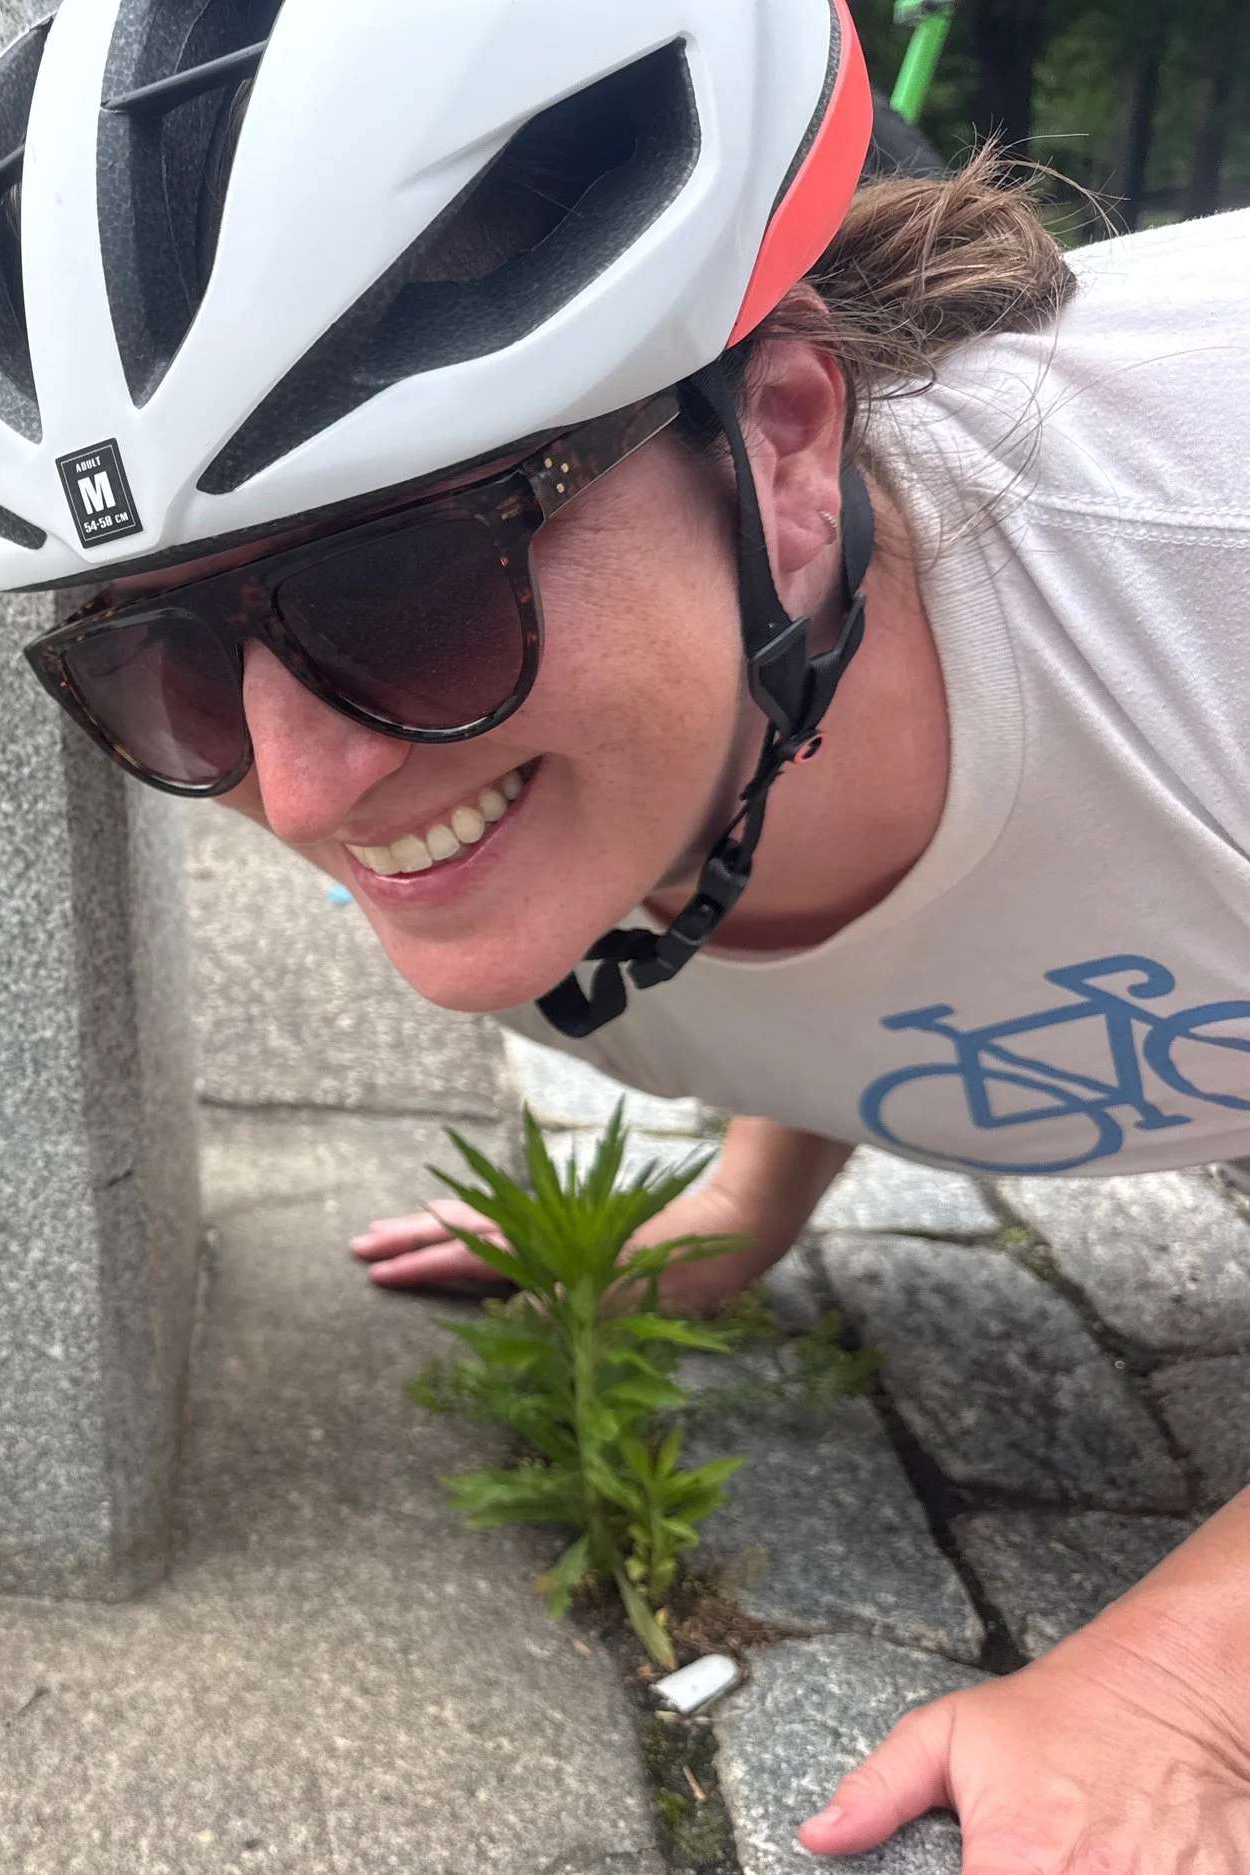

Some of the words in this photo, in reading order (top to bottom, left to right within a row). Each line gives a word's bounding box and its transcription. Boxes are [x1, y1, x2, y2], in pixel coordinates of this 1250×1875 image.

[75, 456, 101, 473] ADULT
[77, 470, 116, 515] M
[83, 515, 113, 533] 54-58
[114, 511, 129, 524] CM
